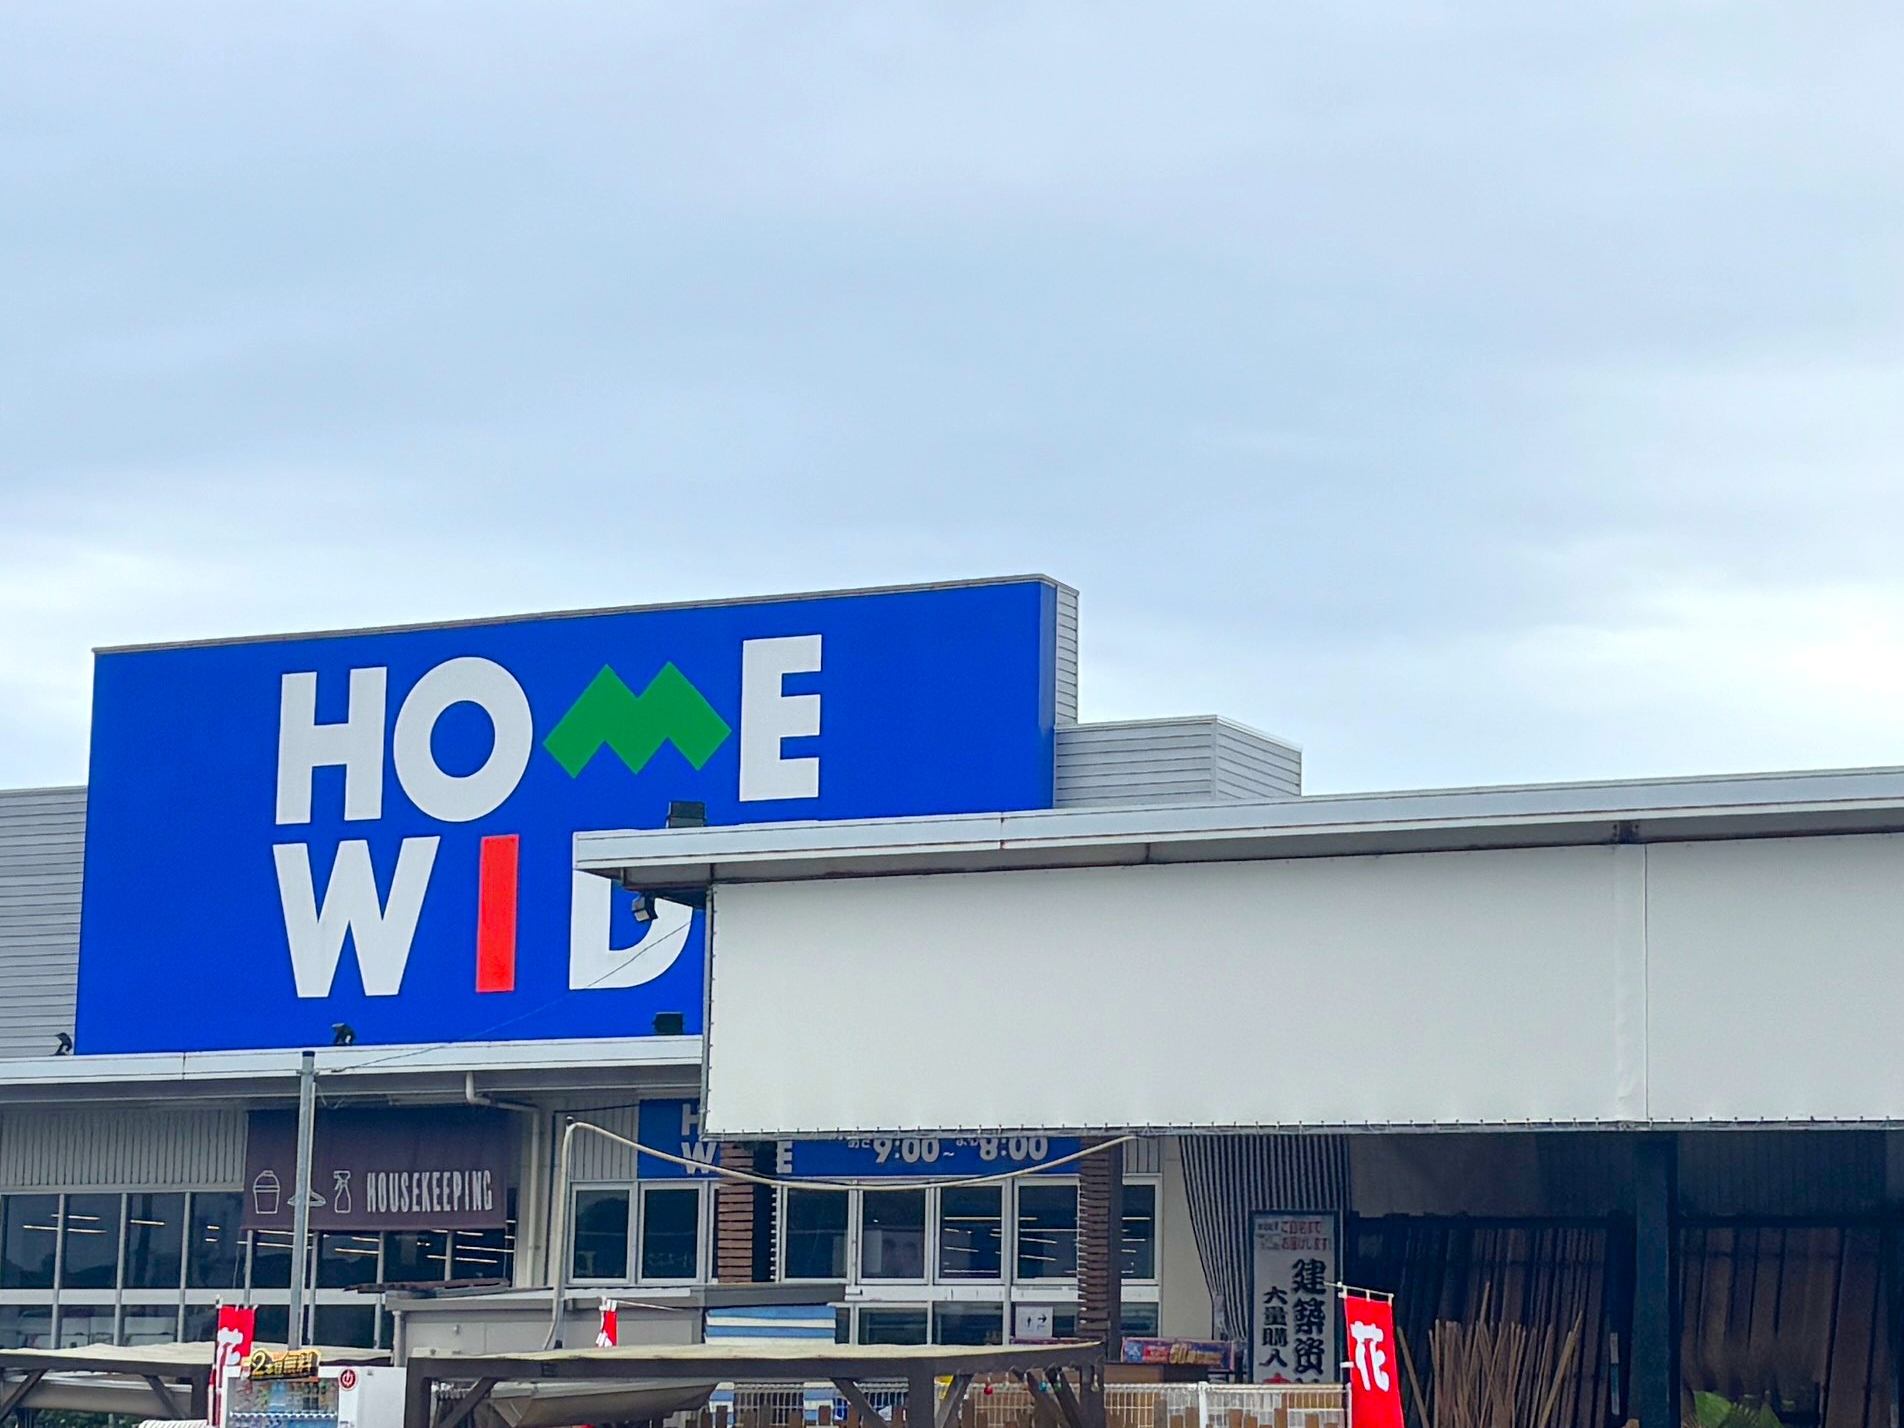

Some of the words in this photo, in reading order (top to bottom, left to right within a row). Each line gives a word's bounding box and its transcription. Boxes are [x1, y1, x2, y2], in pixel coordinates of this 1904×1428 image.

[275, 634, 822, 825] HOME
[271, 833, 694, 998] WID
[366, 1170, 494, 1213] HOUSEKEEPING
[1292, 1258, 1327, 1384] 建築資
